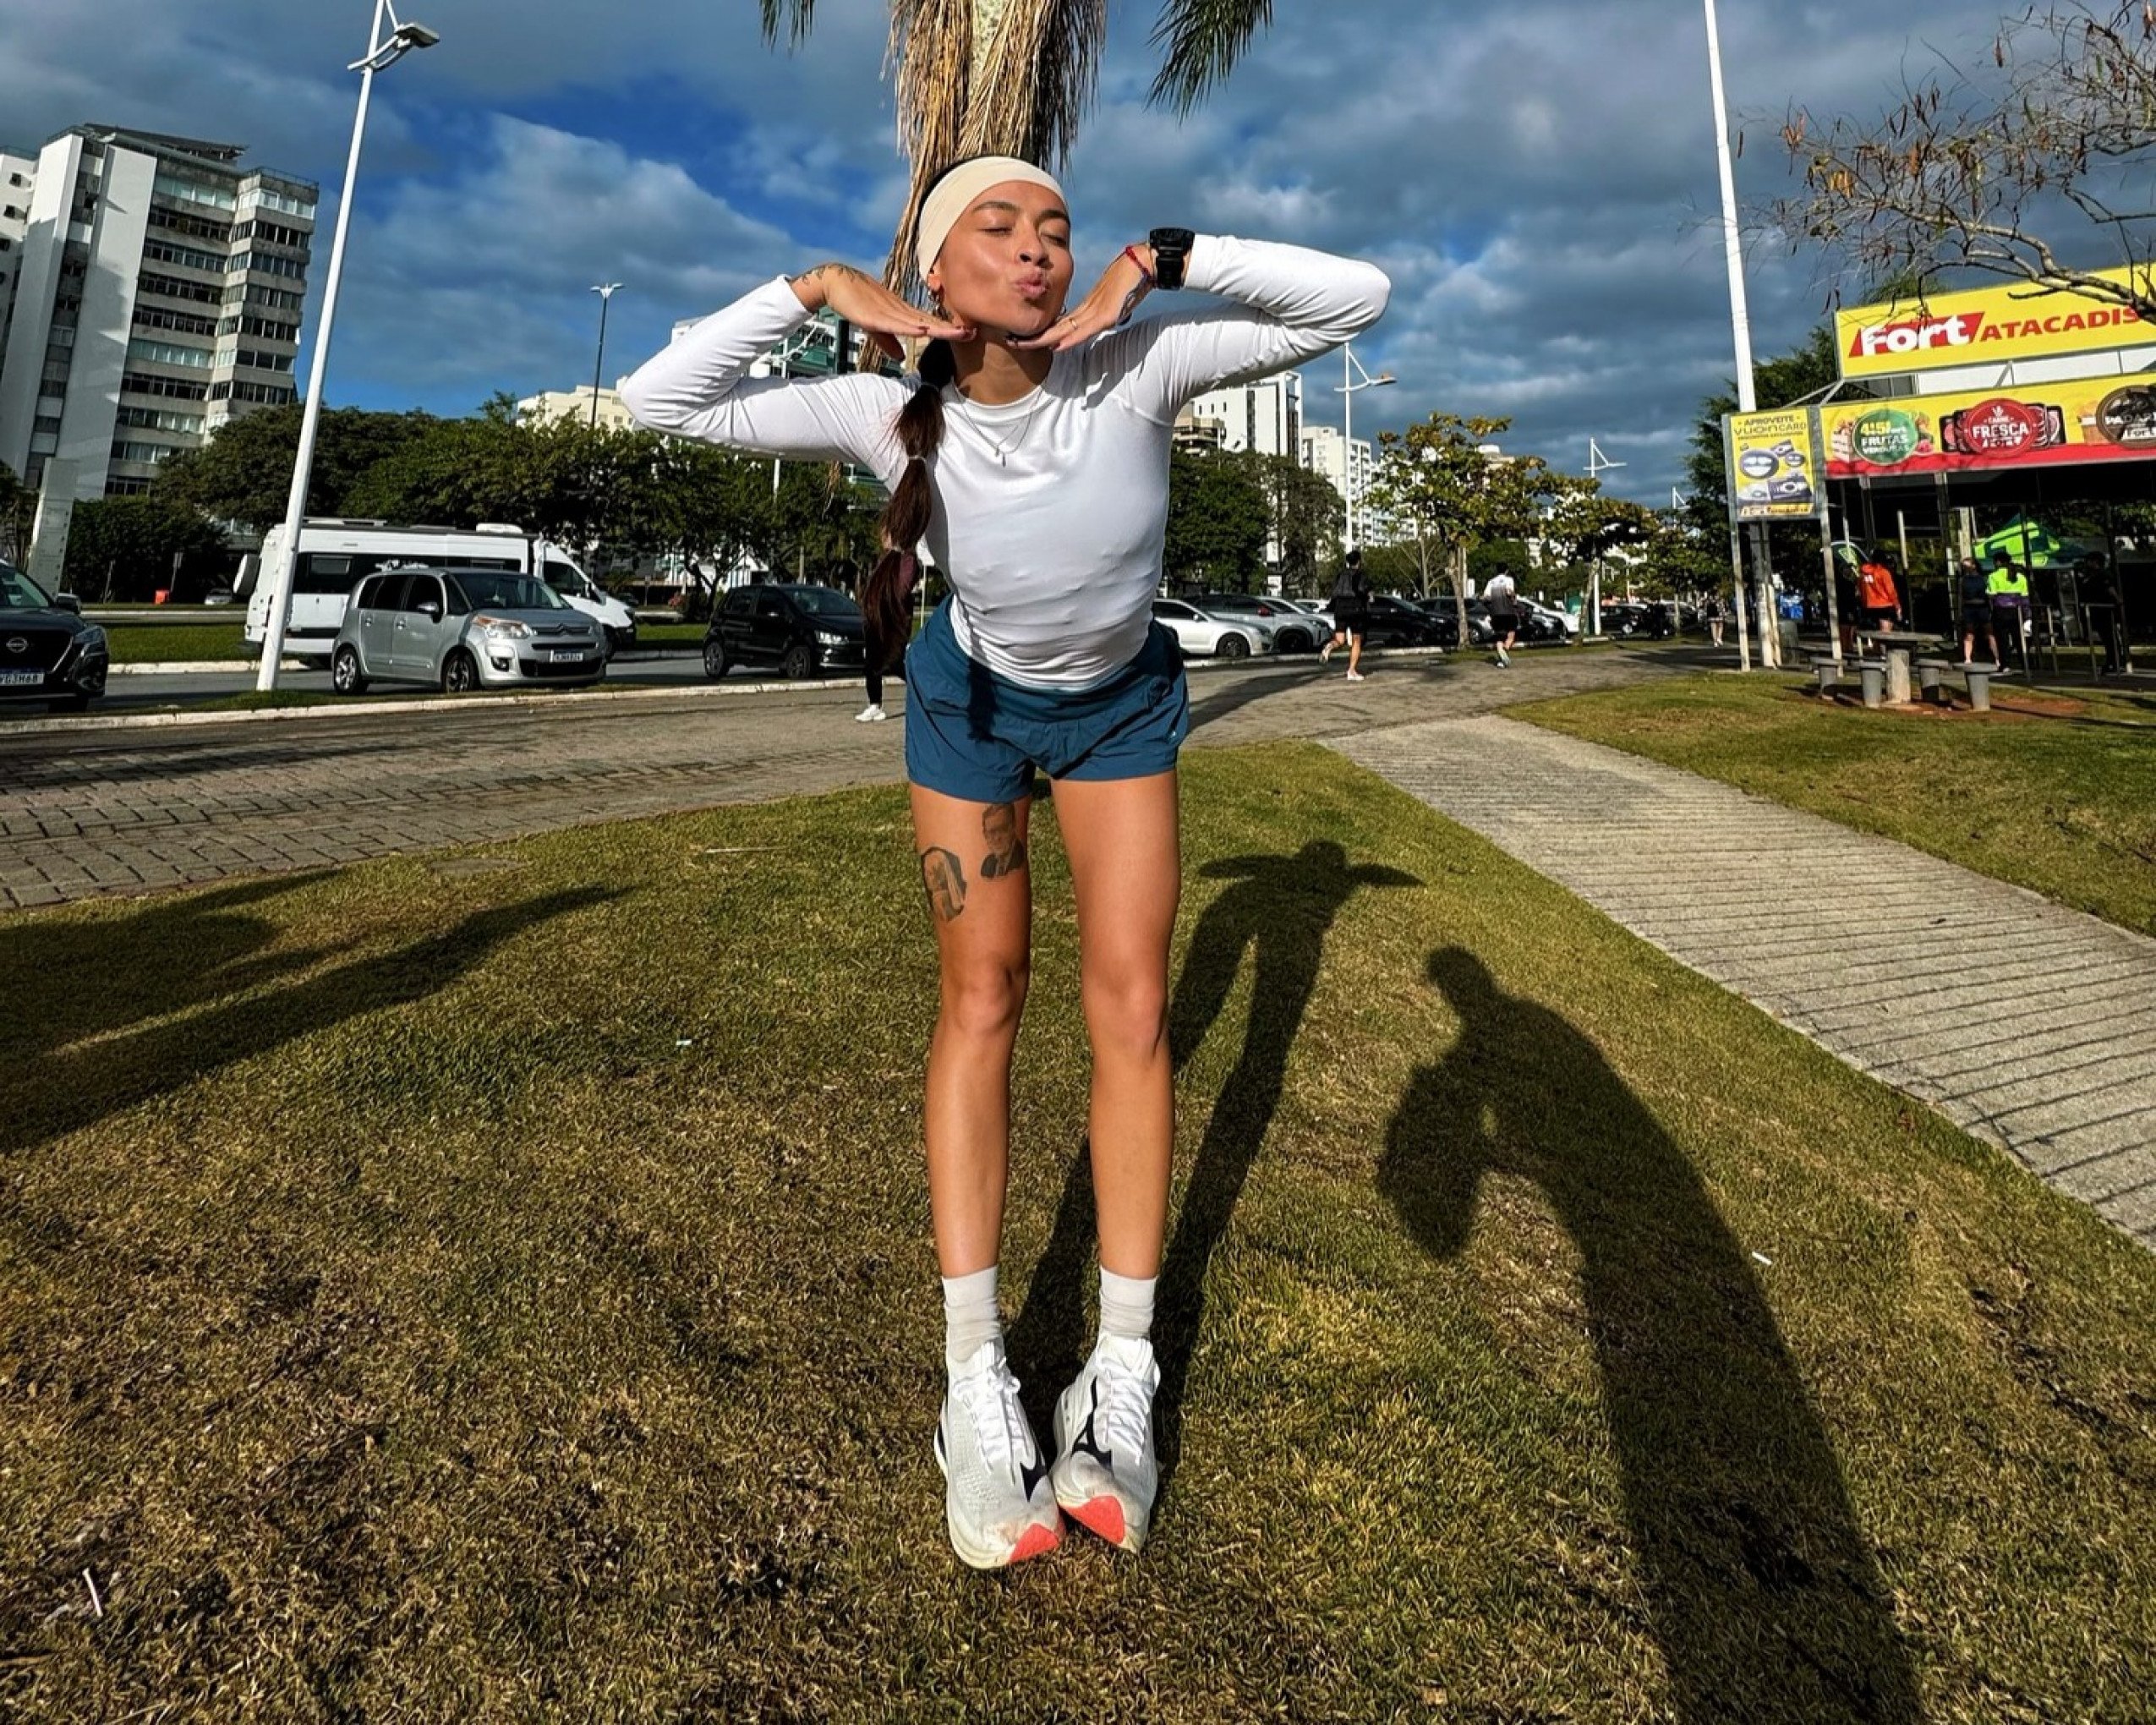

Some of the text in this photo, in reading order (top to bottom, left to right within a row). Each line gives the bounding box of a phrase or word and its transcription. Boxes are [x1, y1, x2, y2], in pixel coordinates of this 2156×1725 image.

[1861, 305, 2142, 356] Fort ATACADIS
[1973, 422, 2029, 438] FRESCA
